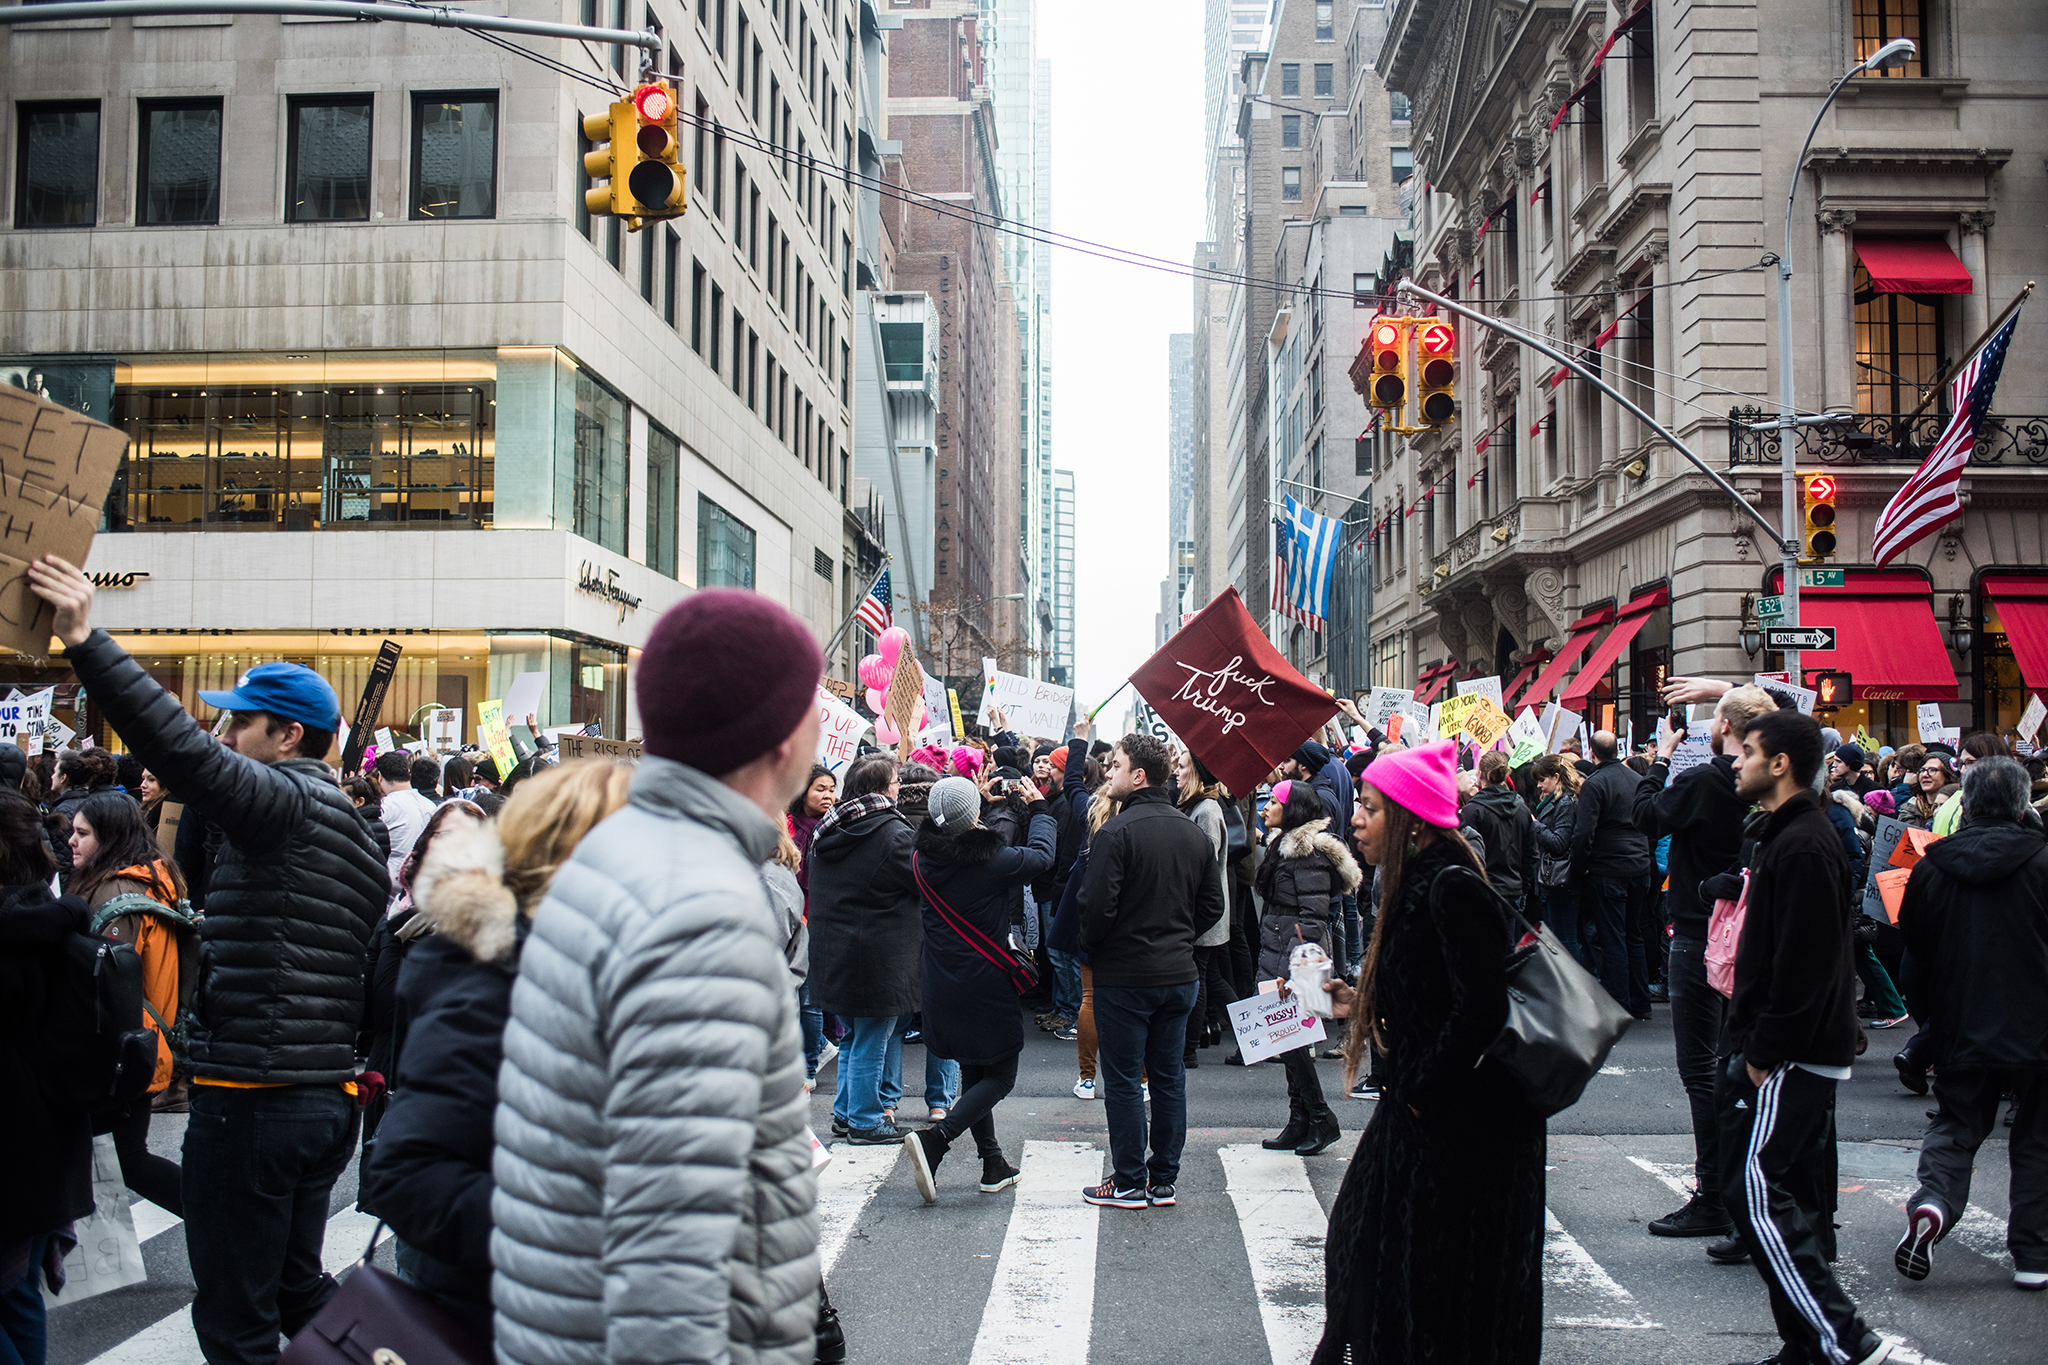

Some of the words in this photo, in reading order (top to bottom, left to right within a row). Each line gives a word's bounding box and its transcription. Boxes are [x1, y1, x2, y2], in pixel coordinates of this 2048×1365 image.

[940, 255, 952, 449] BERKSHIRE
[938, 468, 950, 575] PLACE
[1816, 571, 1825, 585] 5
[1827, 571, 1837, 579] AV
[1759, 601, 1765, 614] E
[1766, 599, 1776, 612] 52
[1775, 634, 1796, 644] ONE
[1804, 634, 1825, 644] WAY
[997, 674, 1028, 696] UILD
[1207, 655, 1276, 706] fuck
[1171, 660, 1246, 735] Trump
[1380, 692, 1406, 701] RIGHTS
[1861, 685, 1904, 700] Cartier
[1441, 698, 1460, 715] MIND
[1460, 693, 1478, 708] YOUR
[1917, 706, 1935, 719] CIVIL
[1, 722, 17, 738] TO
[834, 715, 859, 735] UP
[1028, 709, 1067, 731] WALLS
[1440, 713, 1455, 726] OWN
[1464, 714, 1493, 745] IGNORED
[1921, 721, 1941, 733] RIGHTS
[563, 737, 585, 758] THE
[593, 741, 619, 759] RISE
[826, 733, 855, 762] THE
[1237, 1025, 1252, 1036] YOU
[1253, 1022, 1263, 1031] A
[1263, 1004, 1298, 1025] PUSSY!
[1238, 1010, 1252, 1021] IF
[1249, 1038, 1260, 1049] BE
[1267, 1021, 1302, 1041] PROUD!
